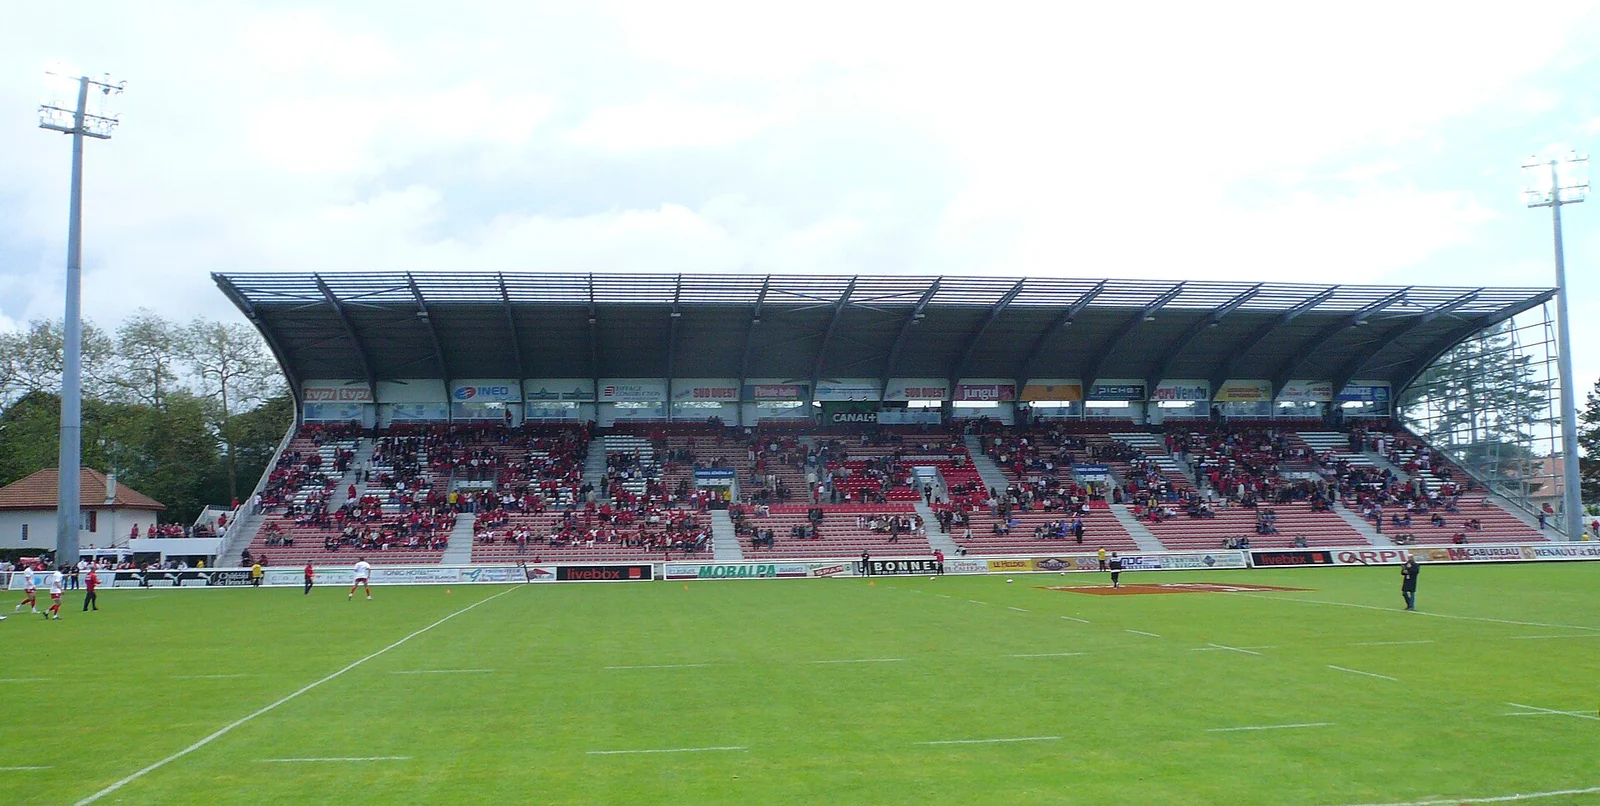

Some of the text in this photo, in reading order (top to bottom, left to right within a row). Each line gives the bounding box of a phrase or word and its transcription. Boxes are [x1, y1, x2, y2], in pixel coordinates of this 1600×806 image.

[477, 386, 509, 396] INEO
[693, 387, 737, 398] SUD OUEST
[963, 385, 998, 400] jungul
[832, 413, 877, 423] CANAL+
[1338, 551, 1407, 563] ORPI
[1535, 548, 1577, 557] RENAULT
[1261, 554, 1307, 565] livebox
[698, 564, 777, 578] MOBALPA
[816, 565, 844, 576] SPAR
[874, 561, 940, 572] BONNET
[567, 567, 620, 580] livebox
